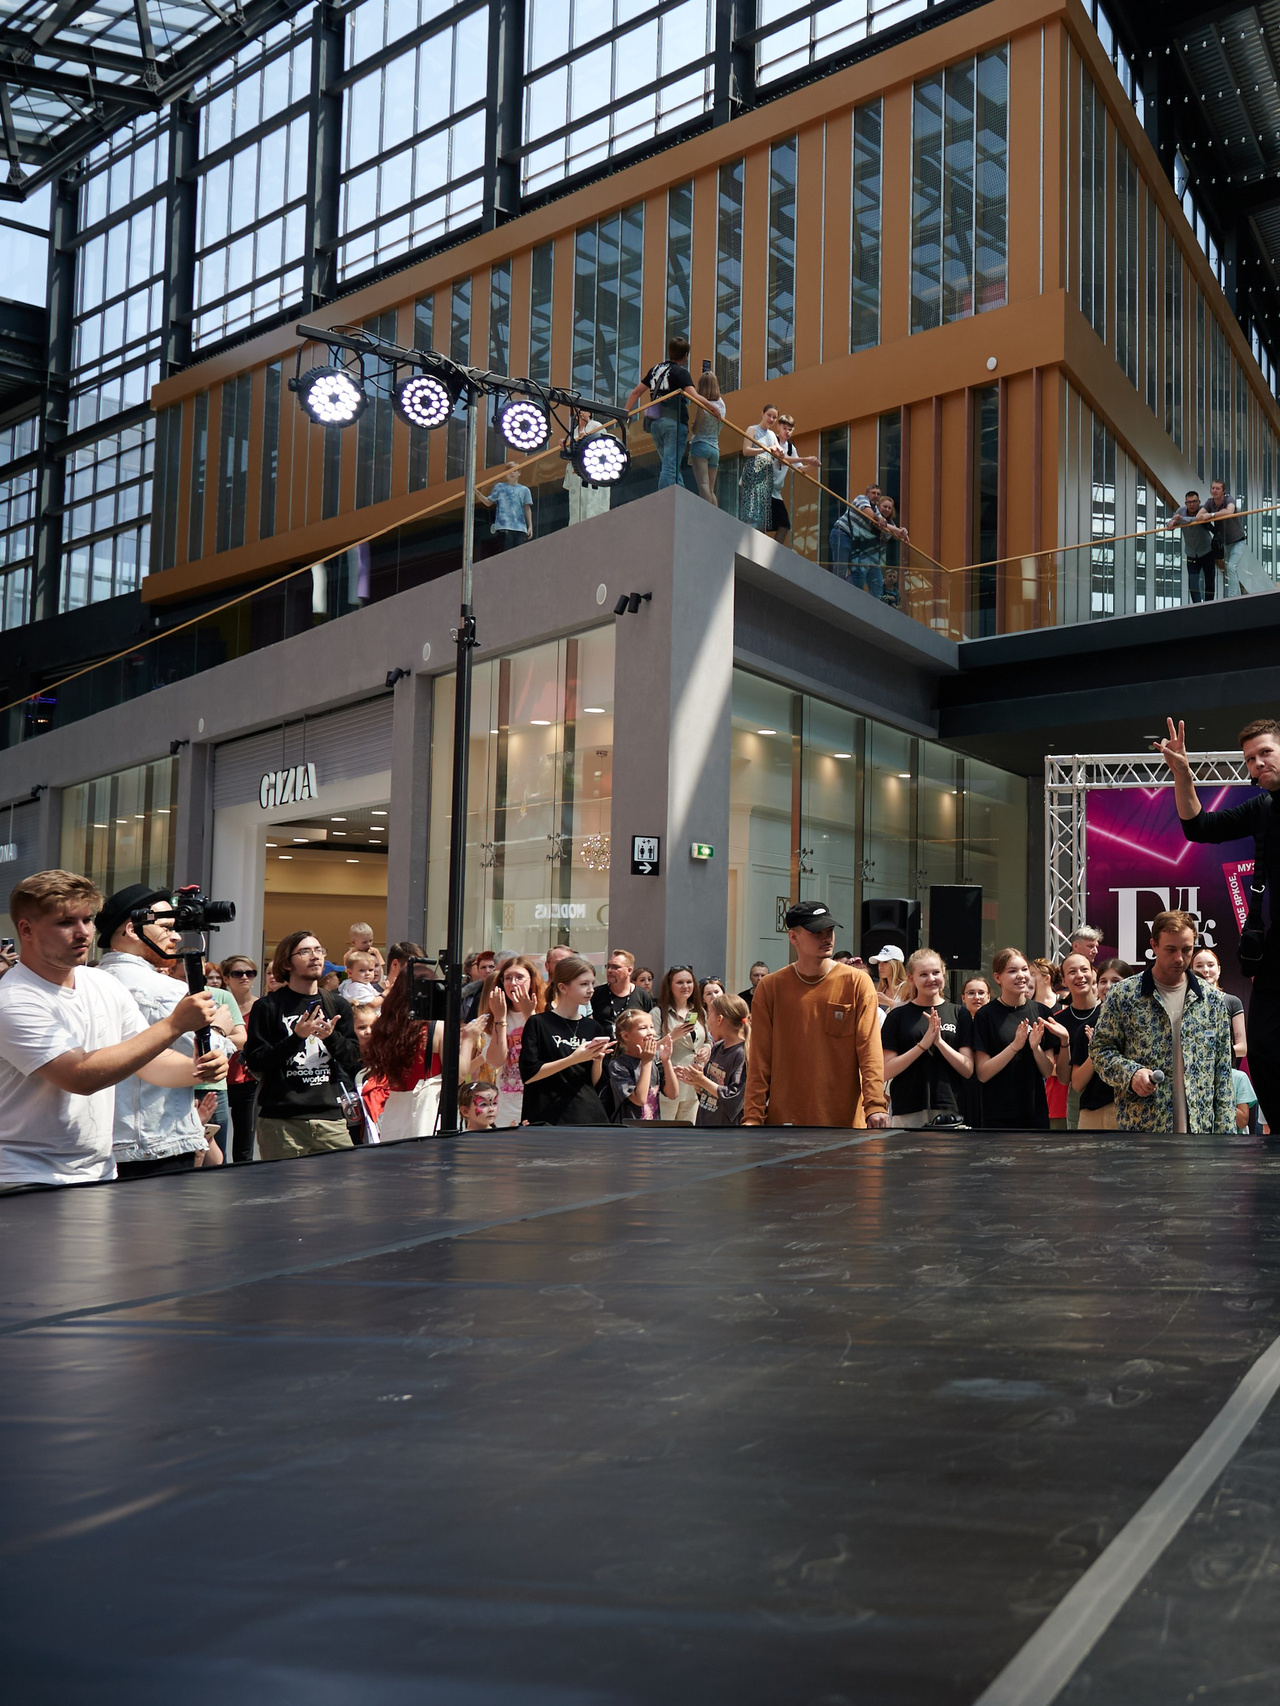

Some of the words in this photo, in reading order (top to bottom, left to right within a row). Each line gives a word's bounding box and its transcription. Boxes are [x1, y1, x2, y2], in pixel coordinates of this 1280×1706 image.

[1228, 872, 1243, 906] ЯРКОЕ,
[286, 1069, 313, 1078] peace
[302, 1075, 329, 1083] worlds
